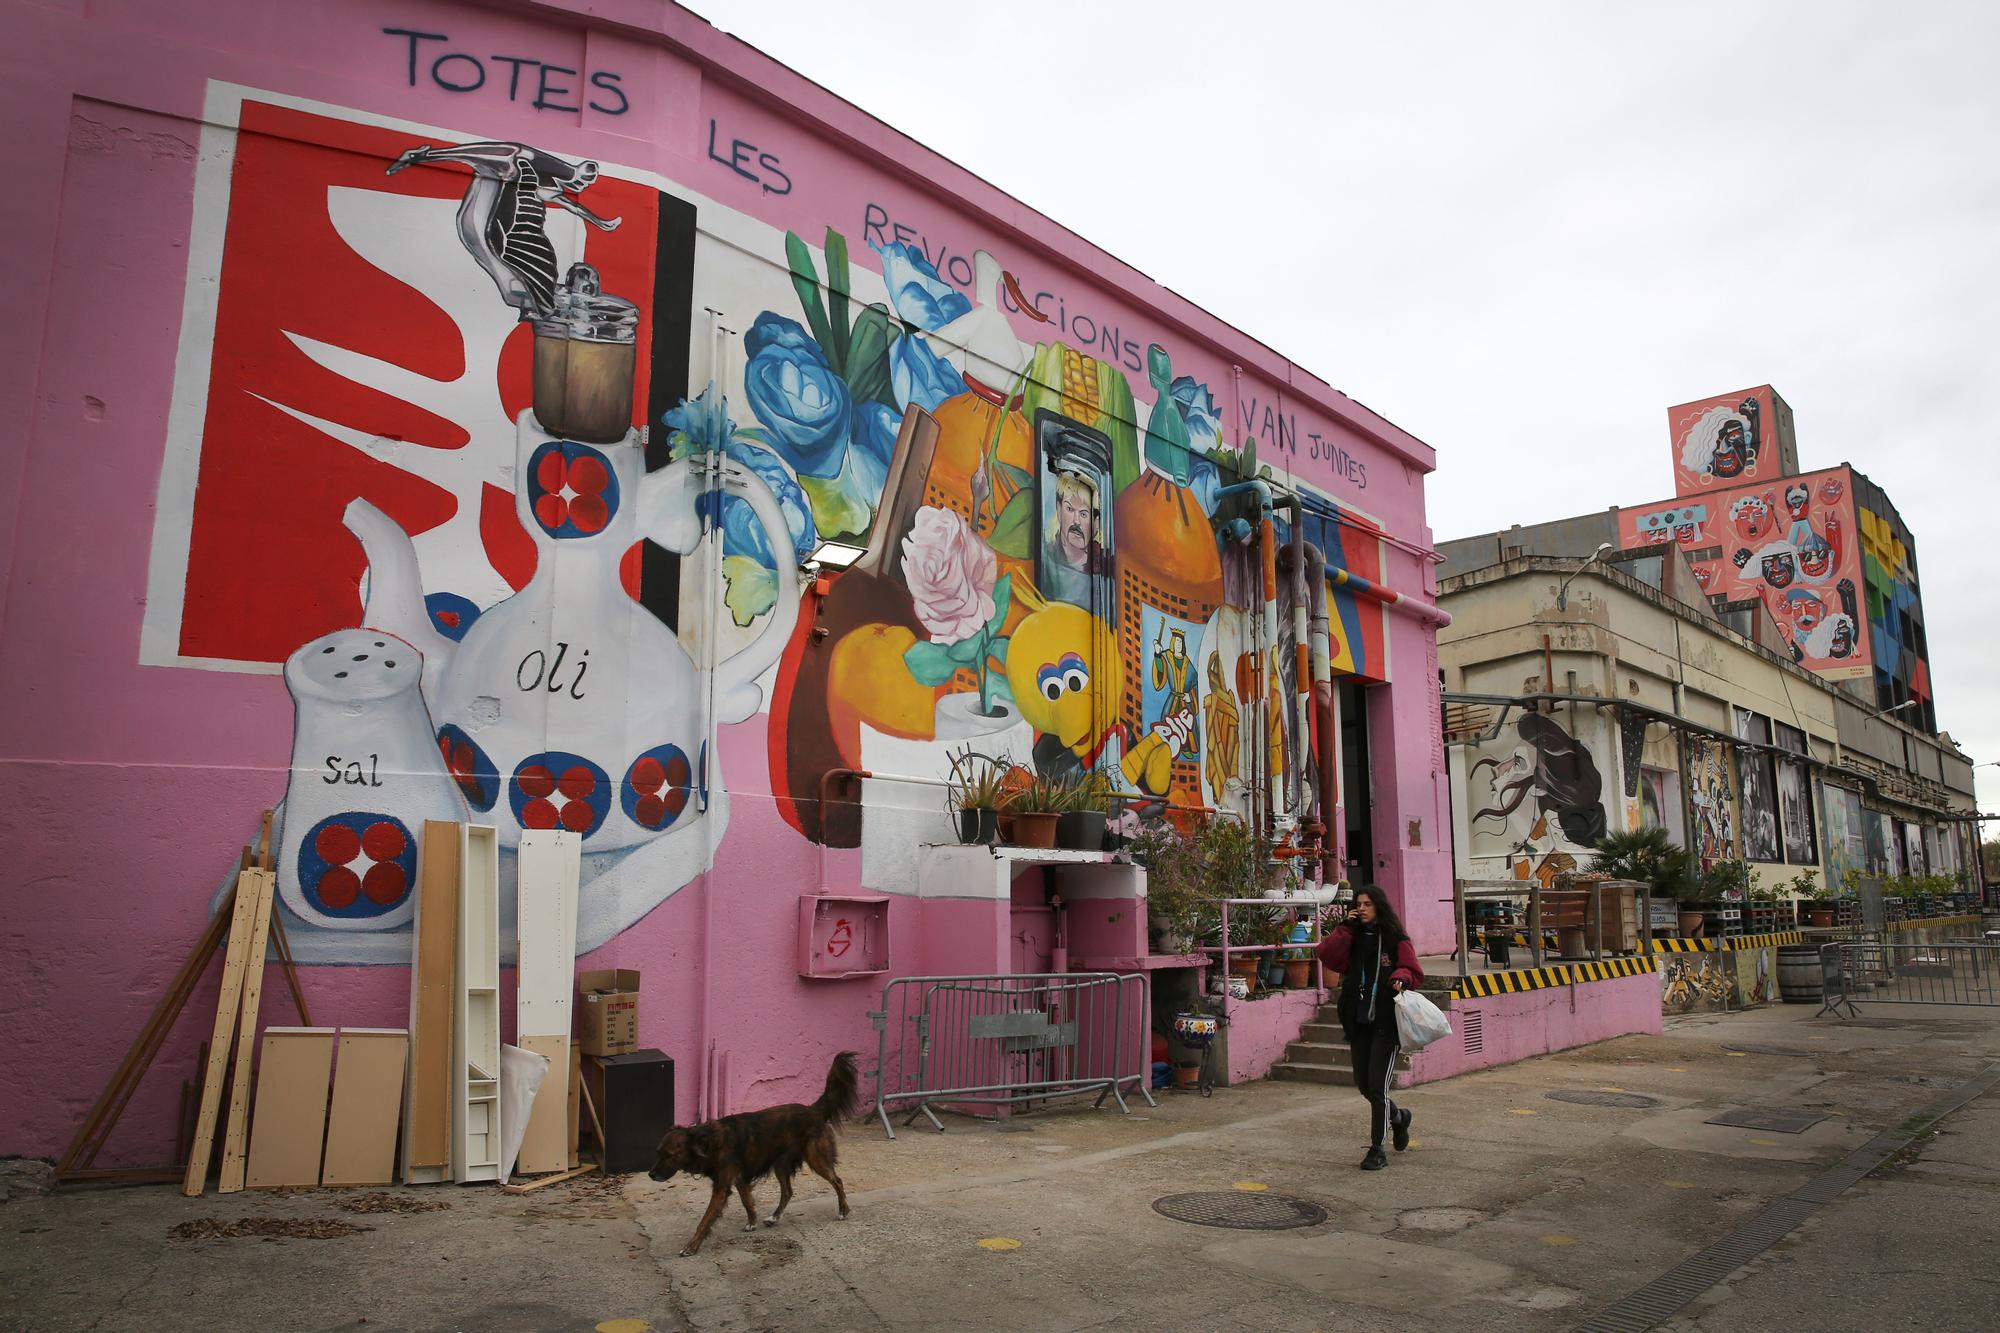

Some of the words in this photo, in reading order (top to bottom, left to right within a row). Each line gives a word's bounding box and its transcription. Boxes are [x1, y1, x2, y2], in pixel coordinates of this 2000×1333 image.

[383, 27, 629, 115] TOTES
[708, 119, 792, 195] LES
[1241, 398, 1296, 455] VAN
[1308, 433, 1367, 489] JUNTES
